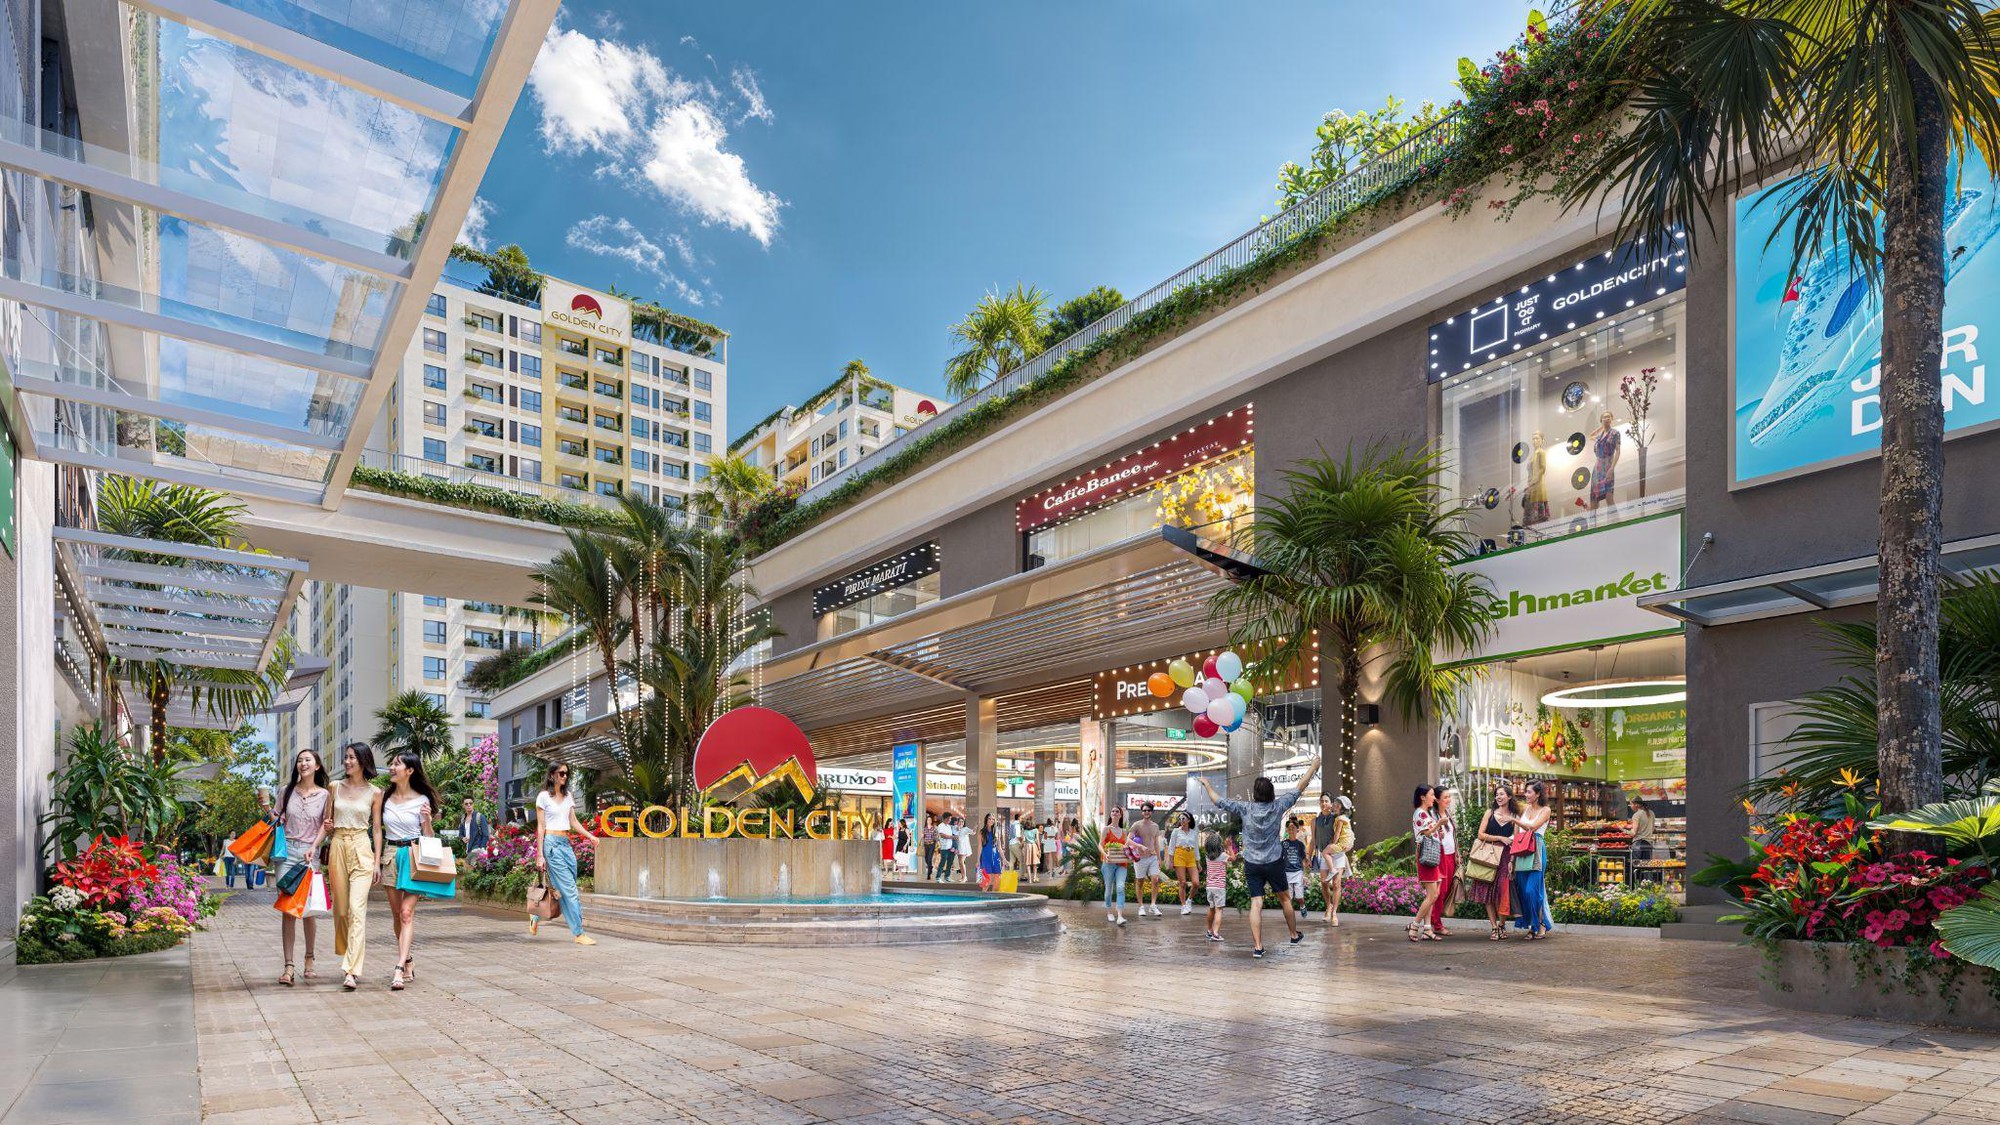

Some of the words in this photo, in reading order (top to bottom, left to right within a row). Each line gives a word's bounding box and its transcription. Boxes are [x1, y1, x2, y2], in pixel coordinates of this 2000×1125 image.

[1514, 294, 1540, 311] JUST
[551, 311, 596, 330] GOLDEN
[598, 324, 623, 338] CITY
[1476, 571, 1667, 622] shmarket
[1626, 711, 1676, 724] ORGANIC
[601, 805, 794, 840] GOLDEN
[805, 810, 873, 840] CITY
